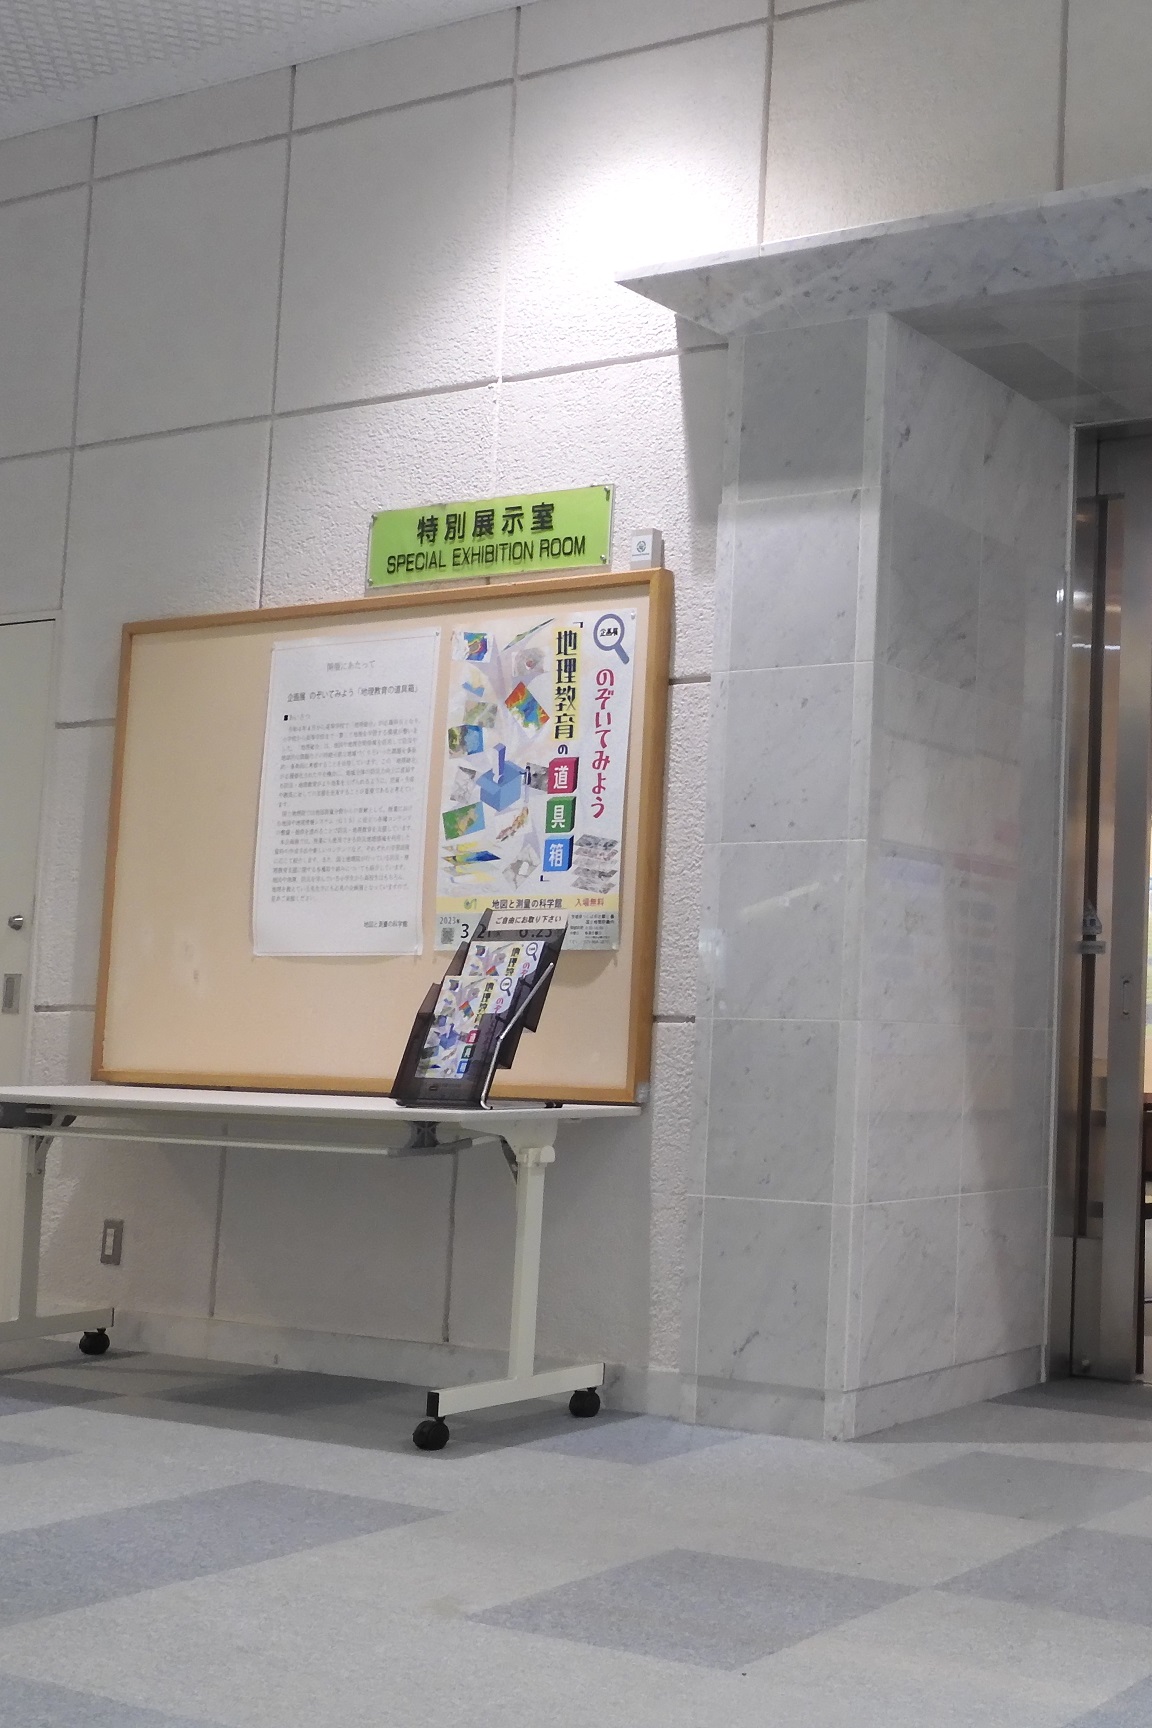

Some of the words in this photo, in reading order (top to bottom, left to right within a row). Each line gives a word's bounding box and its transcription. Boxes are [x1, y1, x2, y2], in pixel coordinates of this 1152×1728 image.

[416, 502, 555, 544] 特別展示室
[386, 550, 446, 574] SPECIAL
[452, 541, 534, 567] EXHIBITION
[539, 536, 586, 558] ROOM
[591, 668, 615, 819] のぞいてみよう
[491, 898, 563, 909] 地図と測量の科学館
[495, 915, 562, 925] ご自由にお取り下さい
